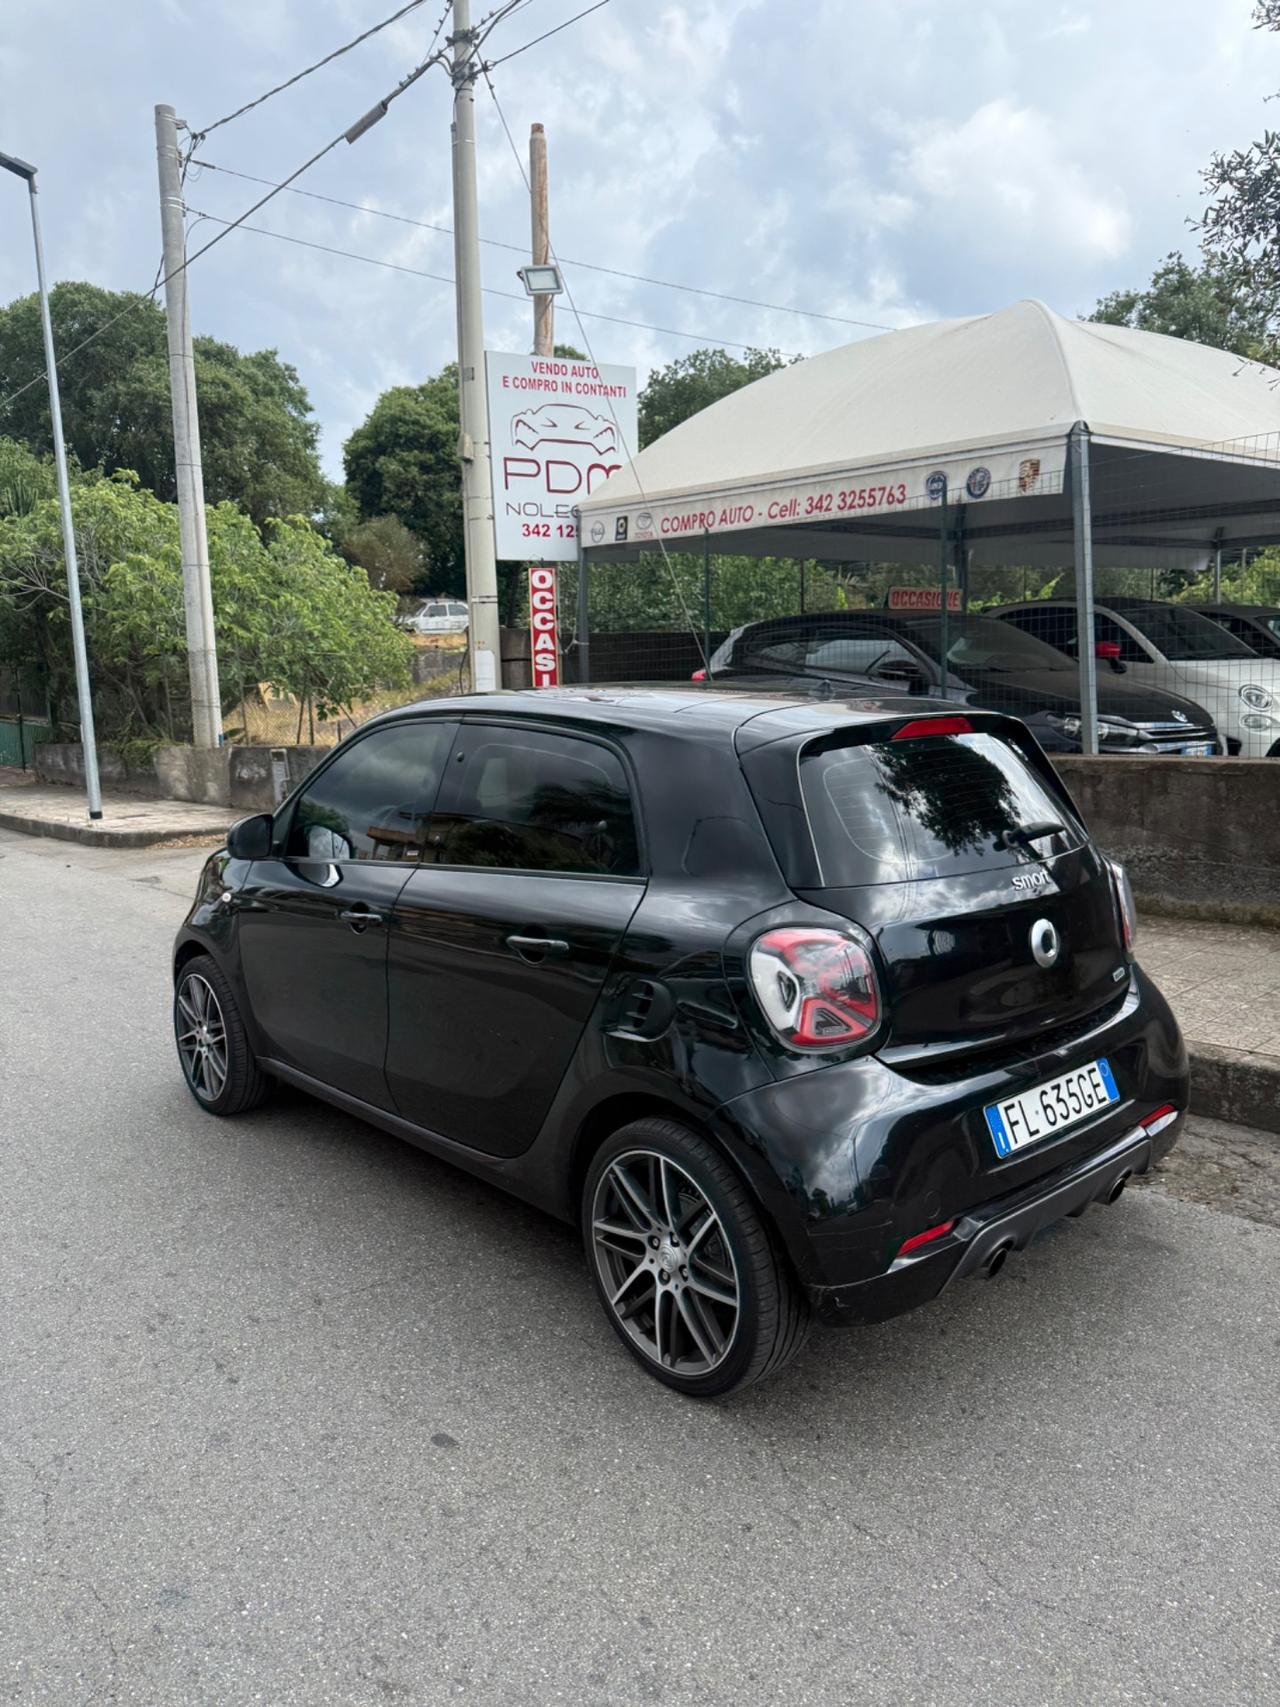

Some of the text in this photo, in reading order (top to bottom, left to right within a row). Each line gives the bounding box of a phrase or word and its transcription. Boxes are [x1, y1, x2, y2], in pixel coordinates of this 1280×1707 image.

[502, 376, 627, 398] E COMPRO IN CONTANTI
[531, 361, 599, 379] VENDO AUTO
[660, 511, 716, 534] COMPRO
[718, 506, 754, 526] AUTO
[767, 498, 801, 520] Cell:
[805, 494, 833, 515] 342
[837, 484, 907, 511] 3255763
[522, 523, 551, 538] 342
[556, 524, 579, 538] 12
[531, 570, 556, 688] OCCASI
[1004, 1100, 1040, 1144] FL
[1040, 1067, 1108, 1127] 635GE
